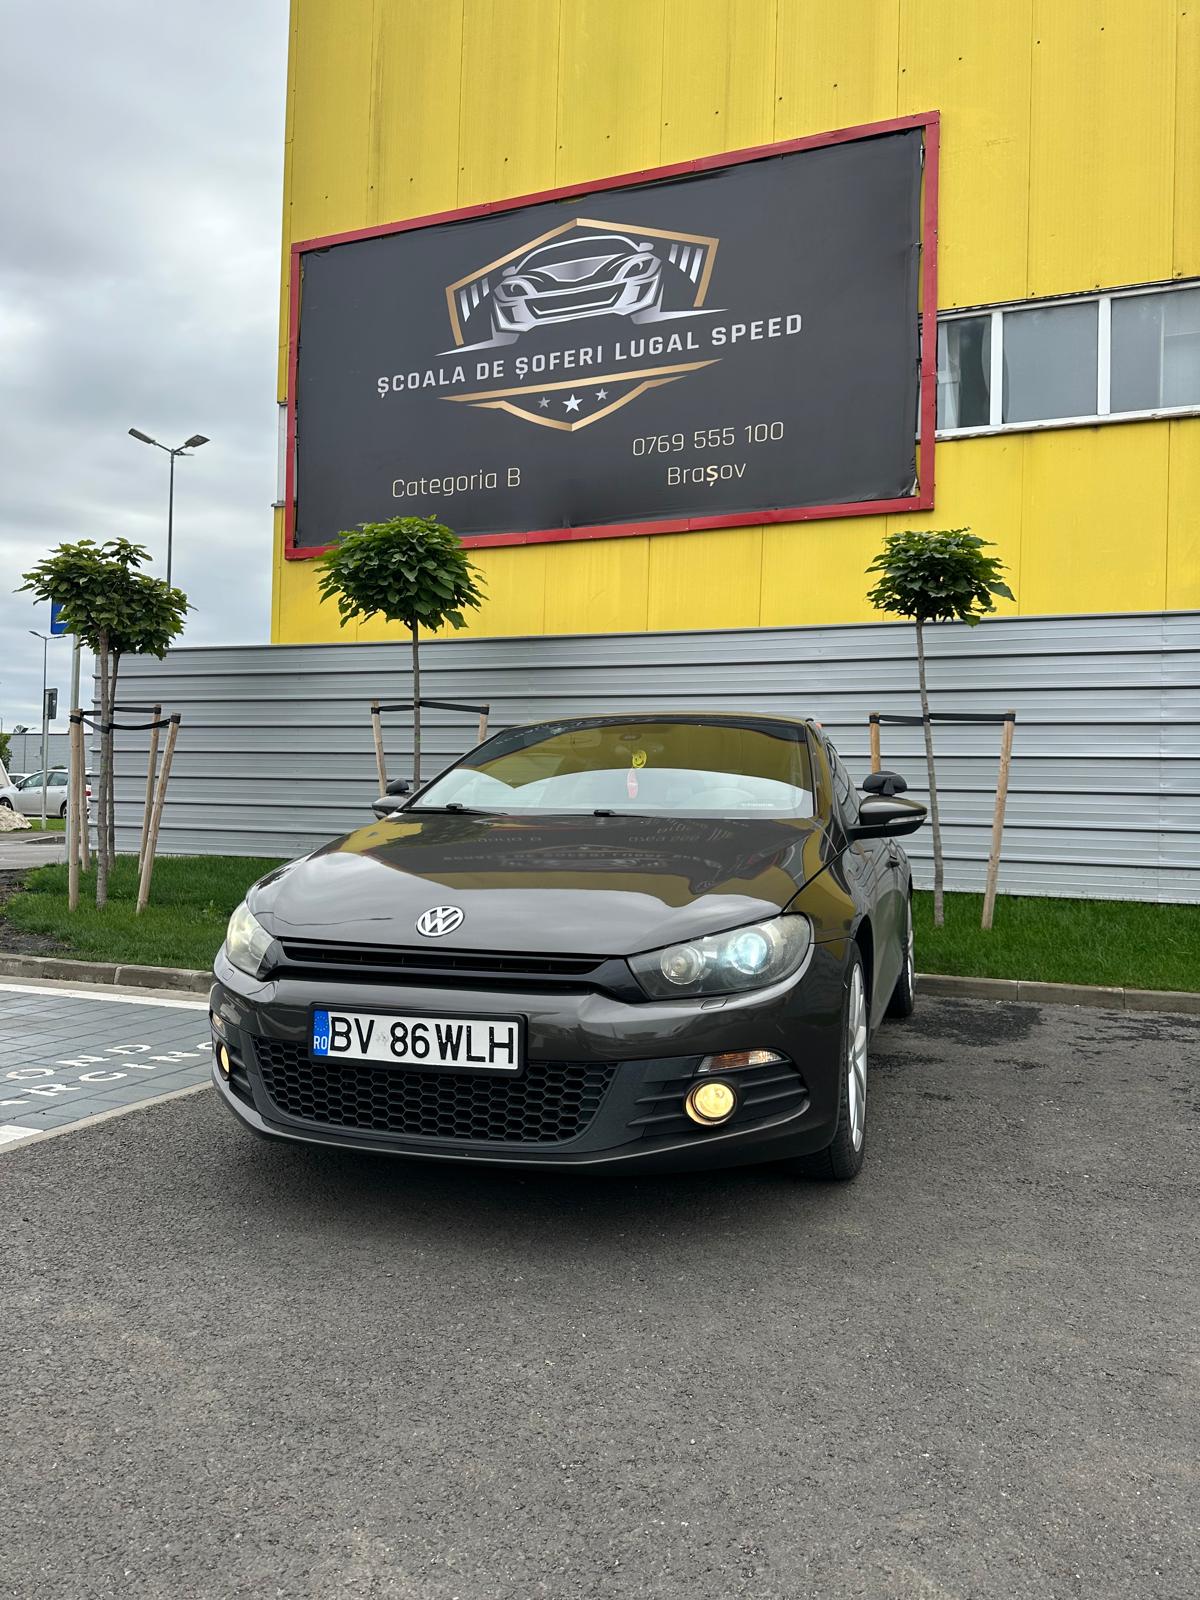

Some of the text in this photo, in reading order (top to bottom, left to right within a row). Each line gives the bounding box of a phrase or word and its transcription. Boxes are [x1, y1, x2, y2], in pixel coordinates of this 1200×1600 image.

[476, 359, 505, 381] DE
[615, 331, 700, 361] LUGAL
[711, 313, 802, 346] SPEED
[632, 421, 784, 457] 0769 555 100
[392, 467, 521, 498] Categoria B
[313, 1035, 328, 1050] RO
[329, 1016, 375, 1055] BV
